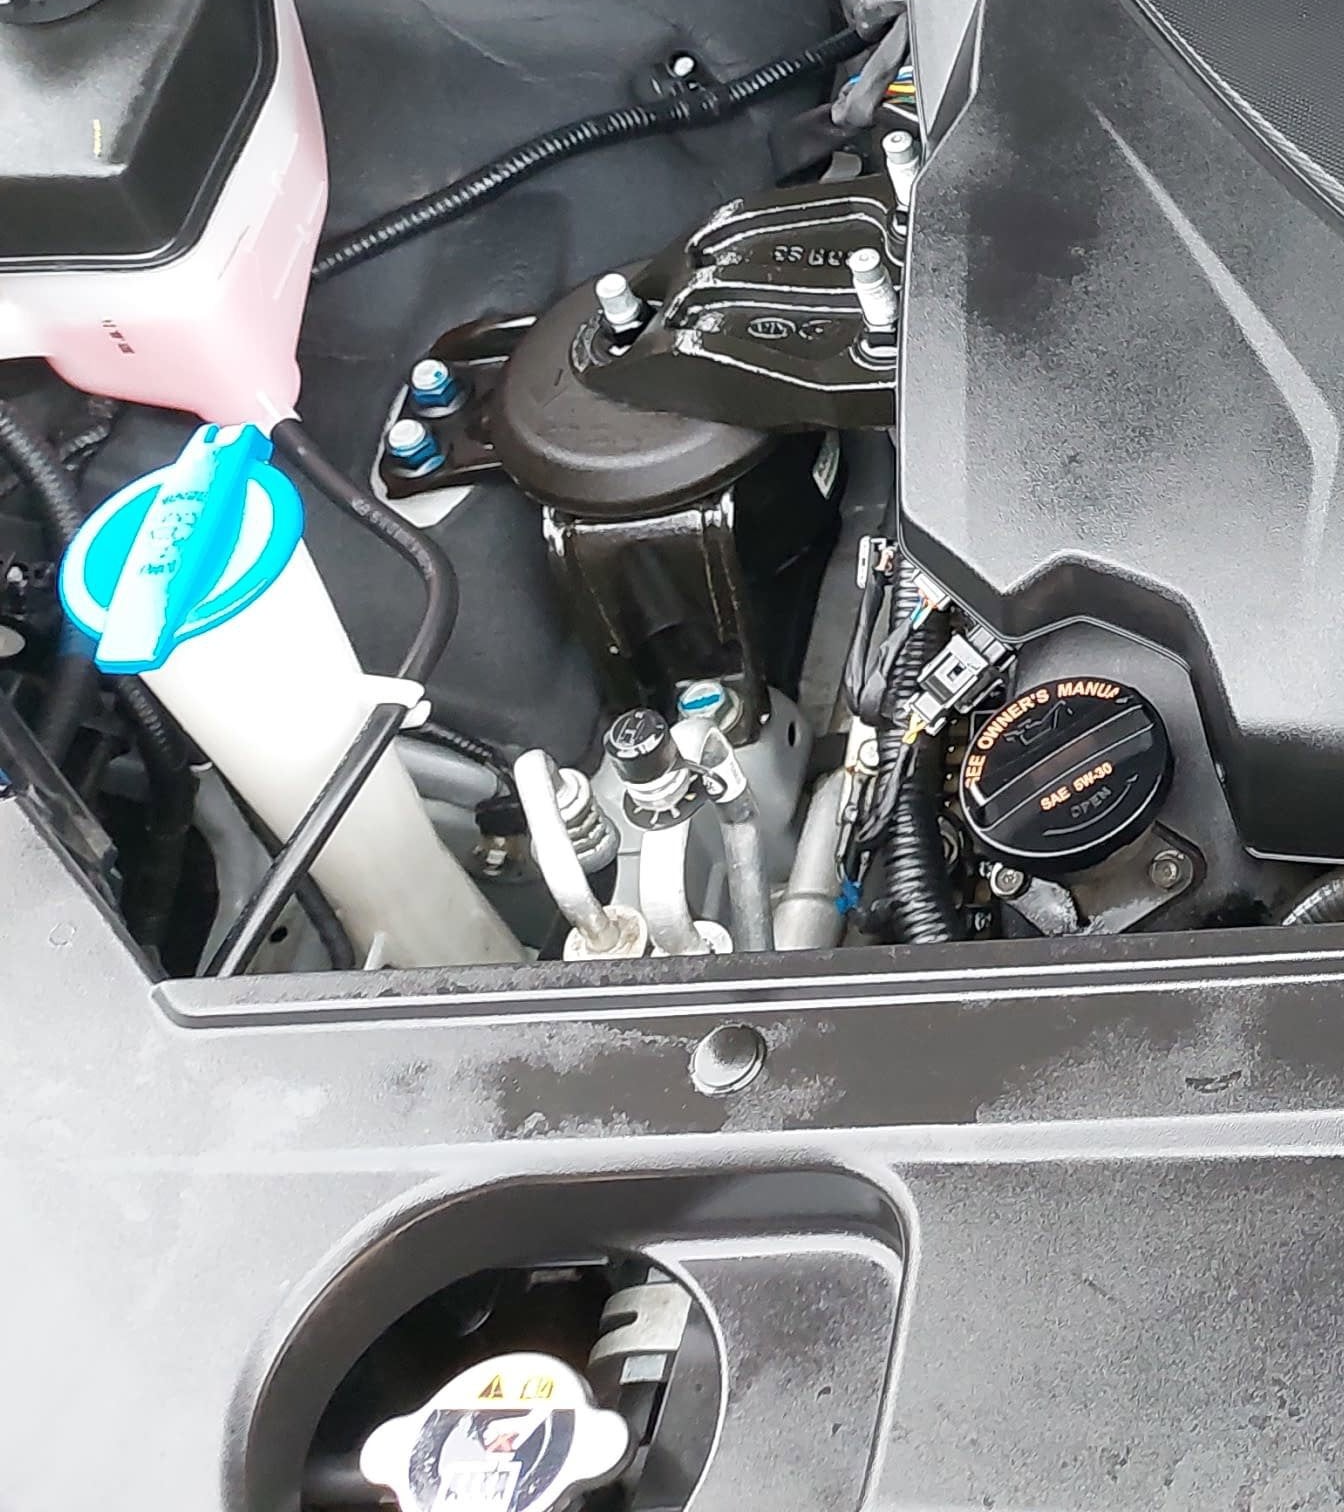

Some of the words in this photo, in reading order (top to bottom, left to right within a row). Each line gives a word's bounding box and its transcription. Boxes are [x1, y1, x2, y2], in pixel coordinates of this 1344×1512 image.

[976, 688, 1051, 751] OWNER'S
[1039, 786, 1072, 812] SAE
[1072, 761, 1114, 793] 5W-30
